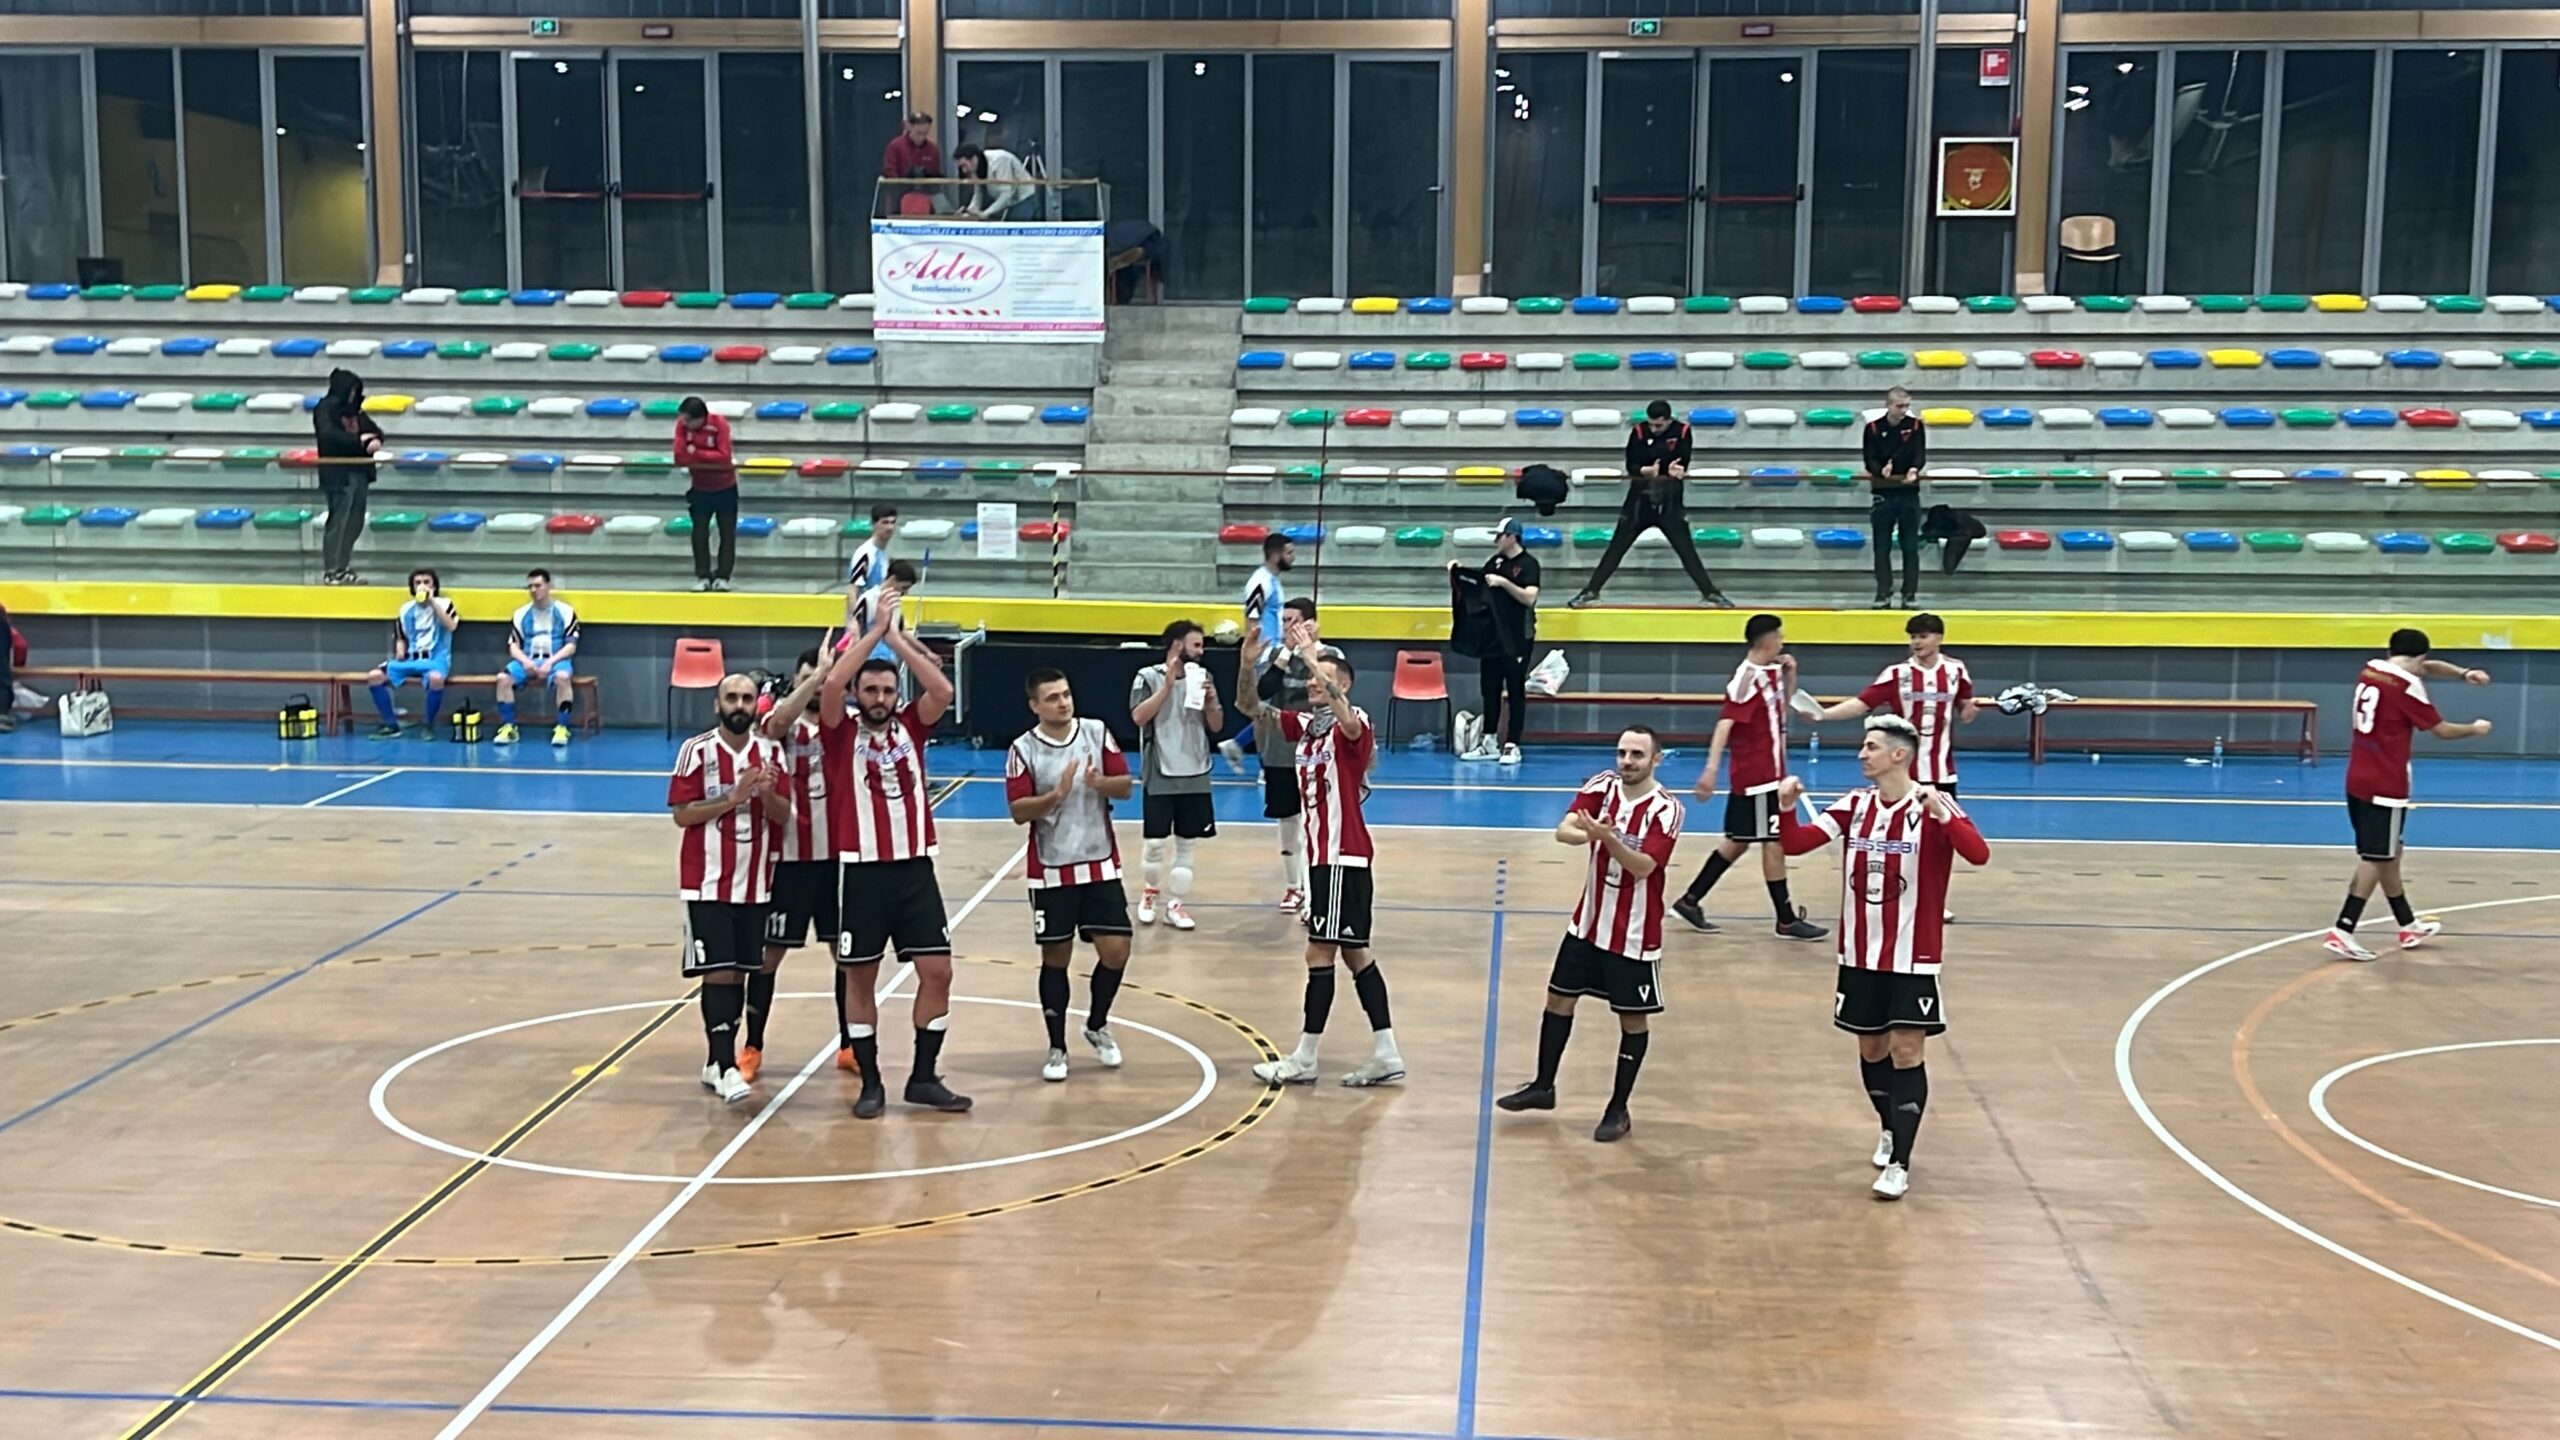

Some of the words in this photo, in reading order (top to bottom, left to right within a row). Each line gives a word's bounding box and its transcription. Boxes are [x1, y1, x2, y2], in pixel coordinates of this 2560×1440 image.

[888, 248, 994, 281] Ada
[2352, 682, 2380, 734] 13
[770, 911, 788, 938] 11
[1035, 910, 1046, 934] 5
[695, 939, 706, 964] 6
[841, 931, 853, 957] 9
